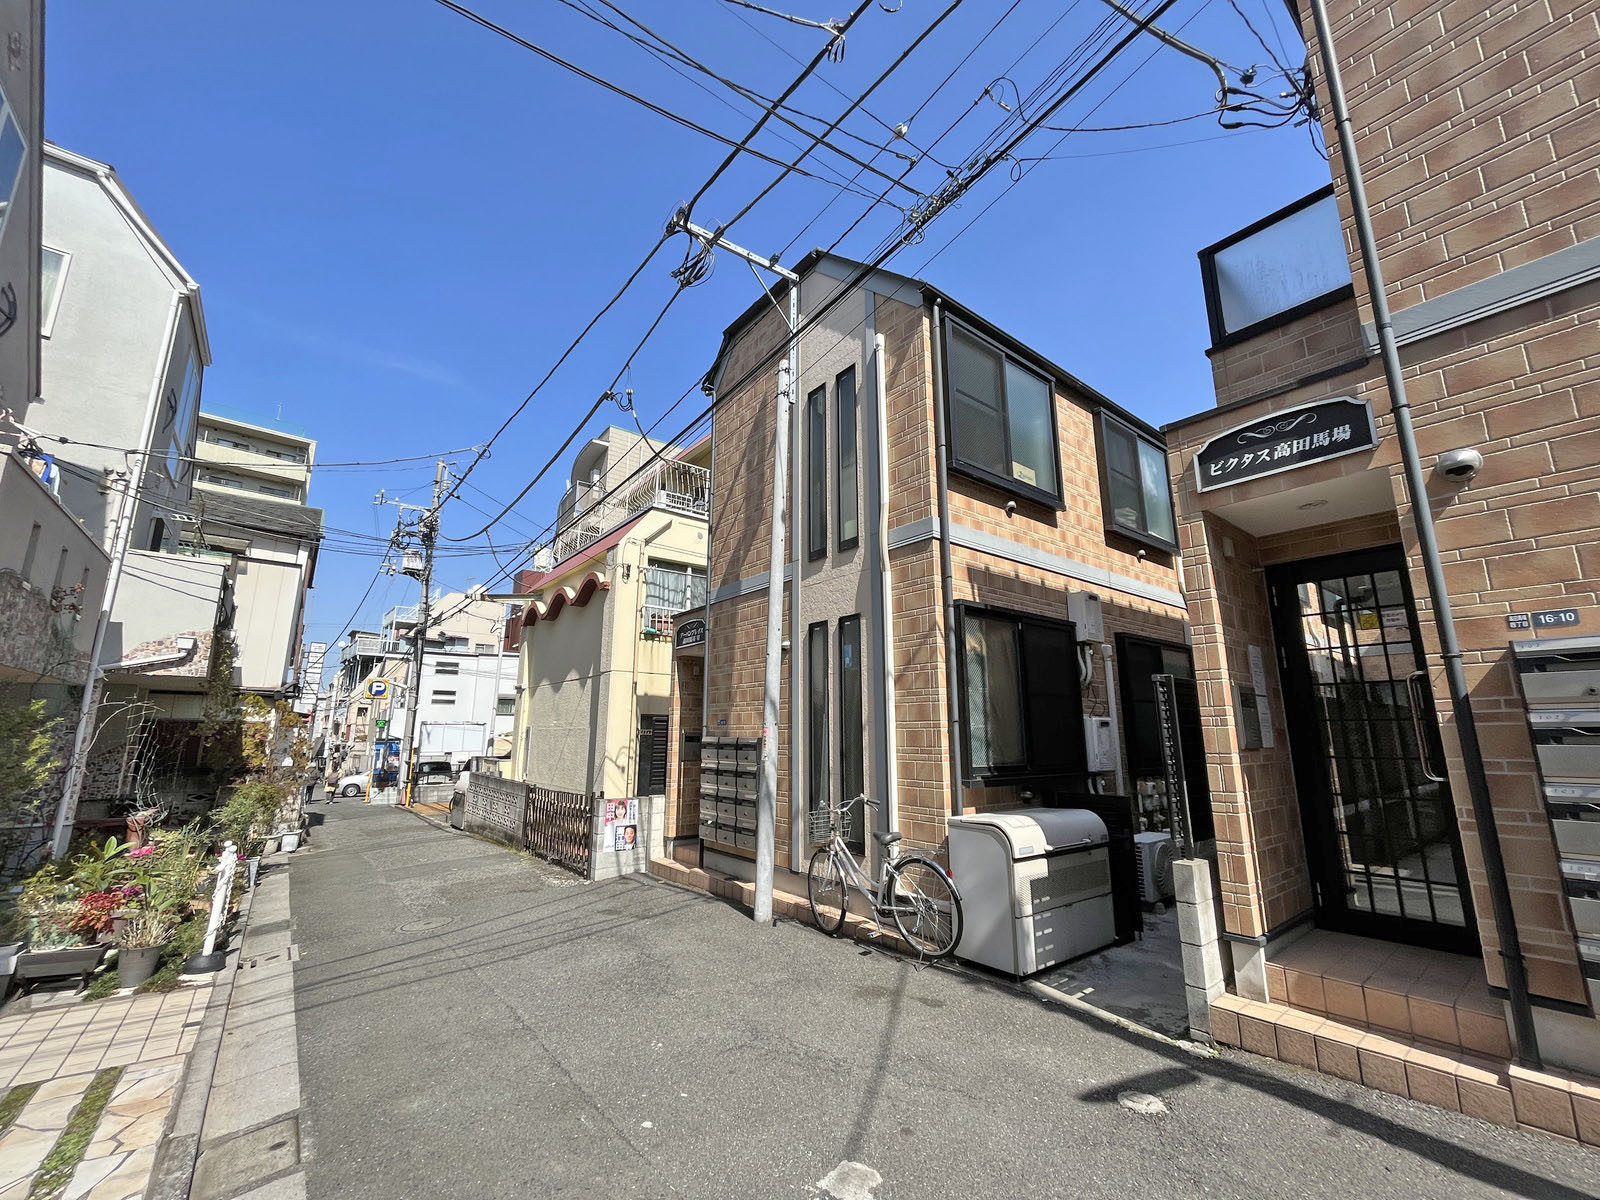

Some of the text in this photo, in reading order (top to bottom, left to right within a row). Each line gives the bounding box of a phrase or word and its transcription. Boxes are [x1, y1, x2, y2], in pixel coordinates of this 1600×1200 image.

[1210, 424, 1353, 477] ビクタス高田馬場
[1539, 612, 1575, 624] 16-10
[371, 682, 386, 695] P
